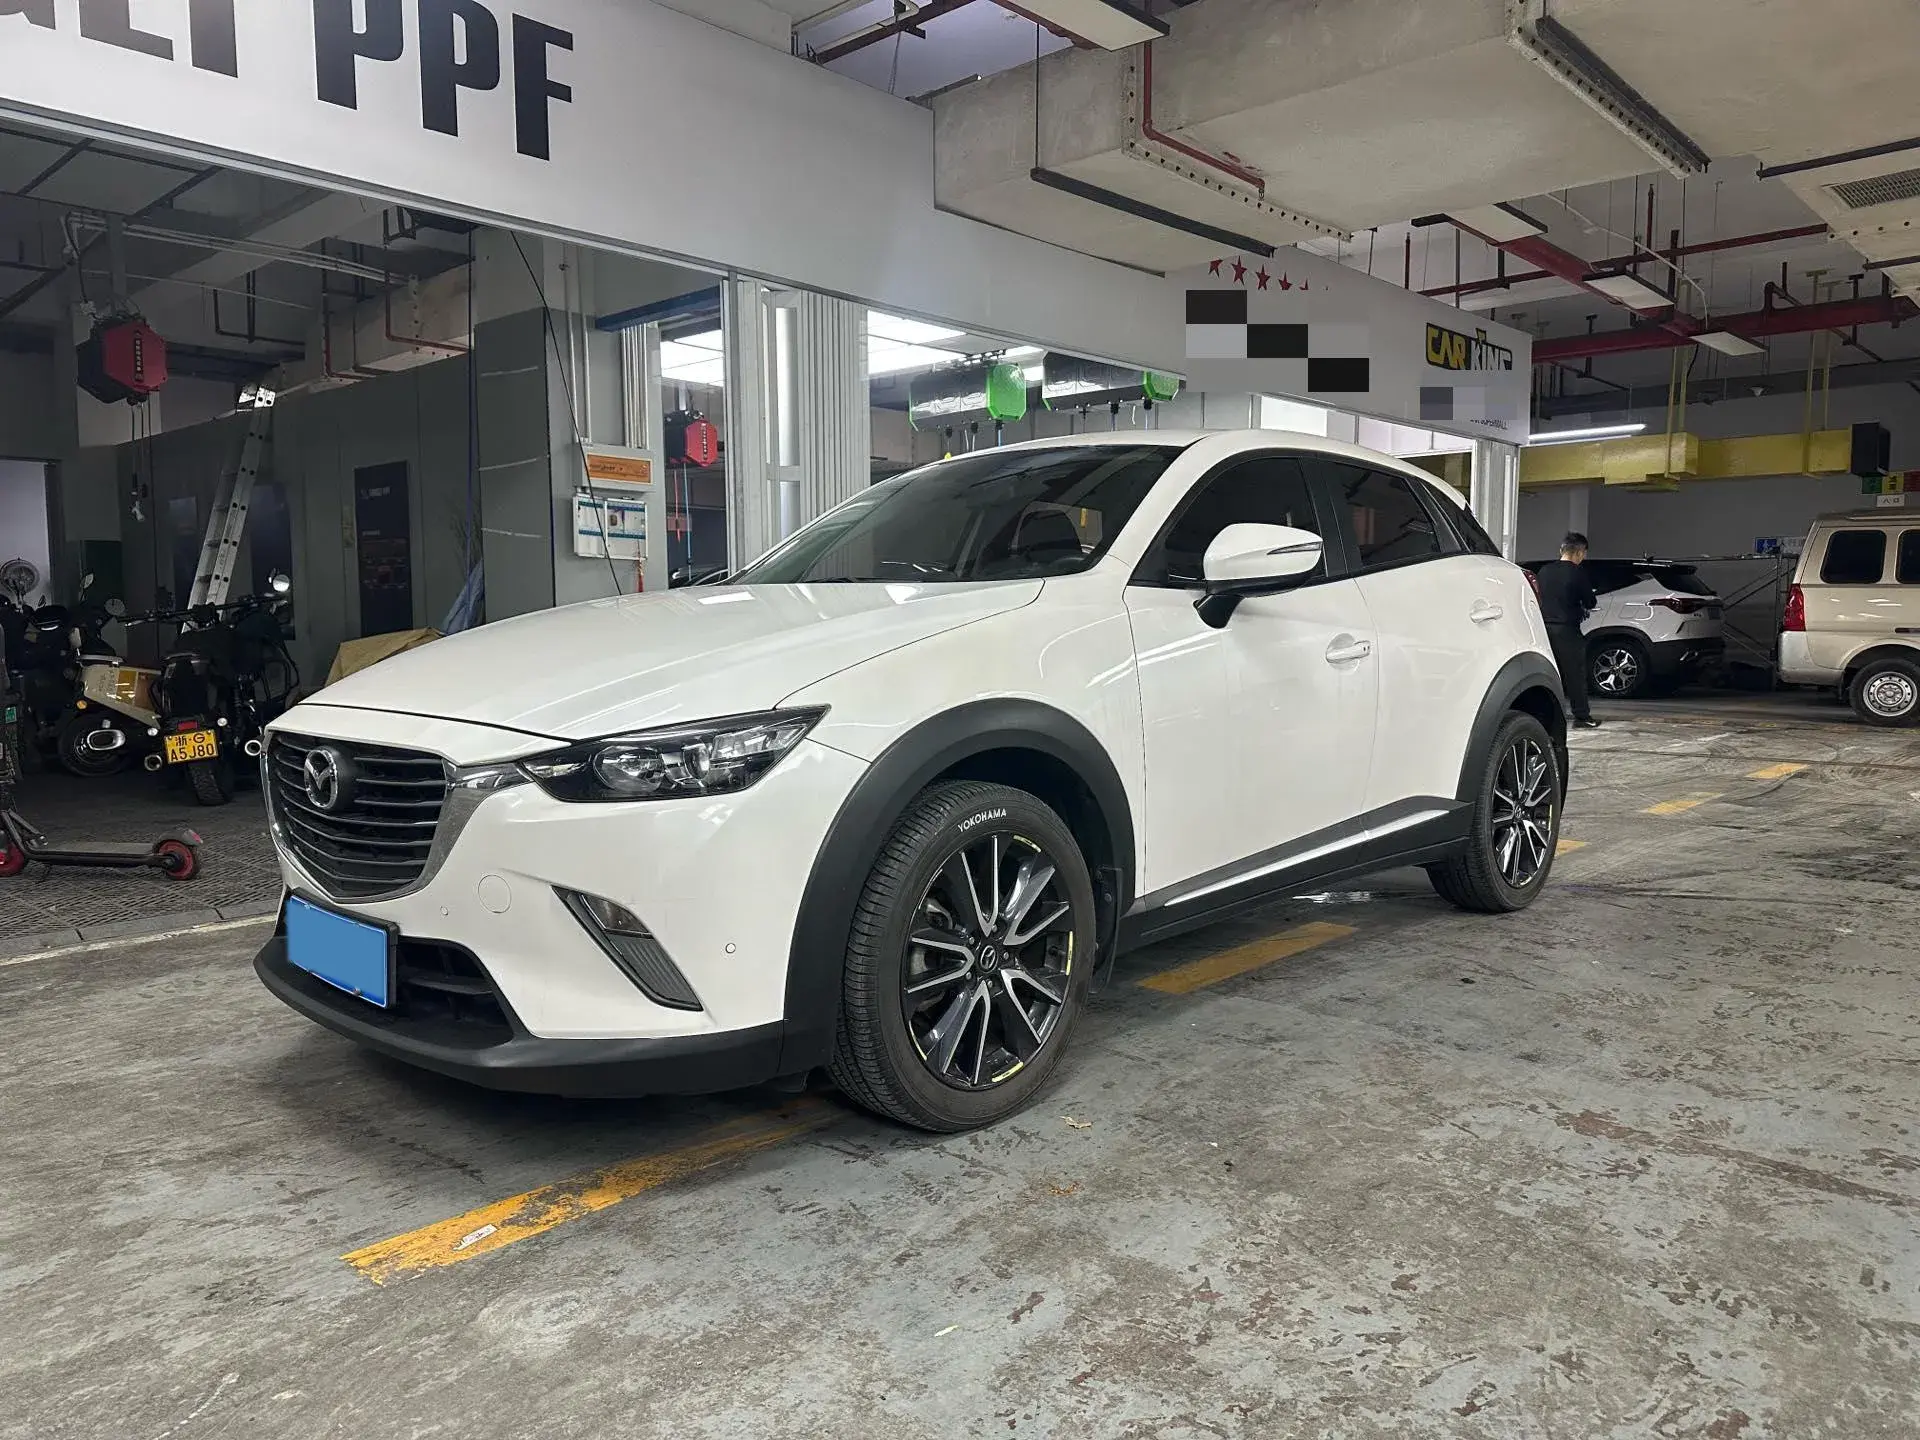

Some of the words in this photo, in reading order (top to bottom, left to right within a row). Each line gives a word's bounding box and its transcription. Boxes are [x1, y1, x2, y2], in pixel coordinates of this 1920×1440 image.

[312, 0, 573, 161] PPF
[1427, 327, 1466, 370] CAR
[171, 743, 214, 761] A5J80
[957, 808, 1006, 832] YOKOHAMA
